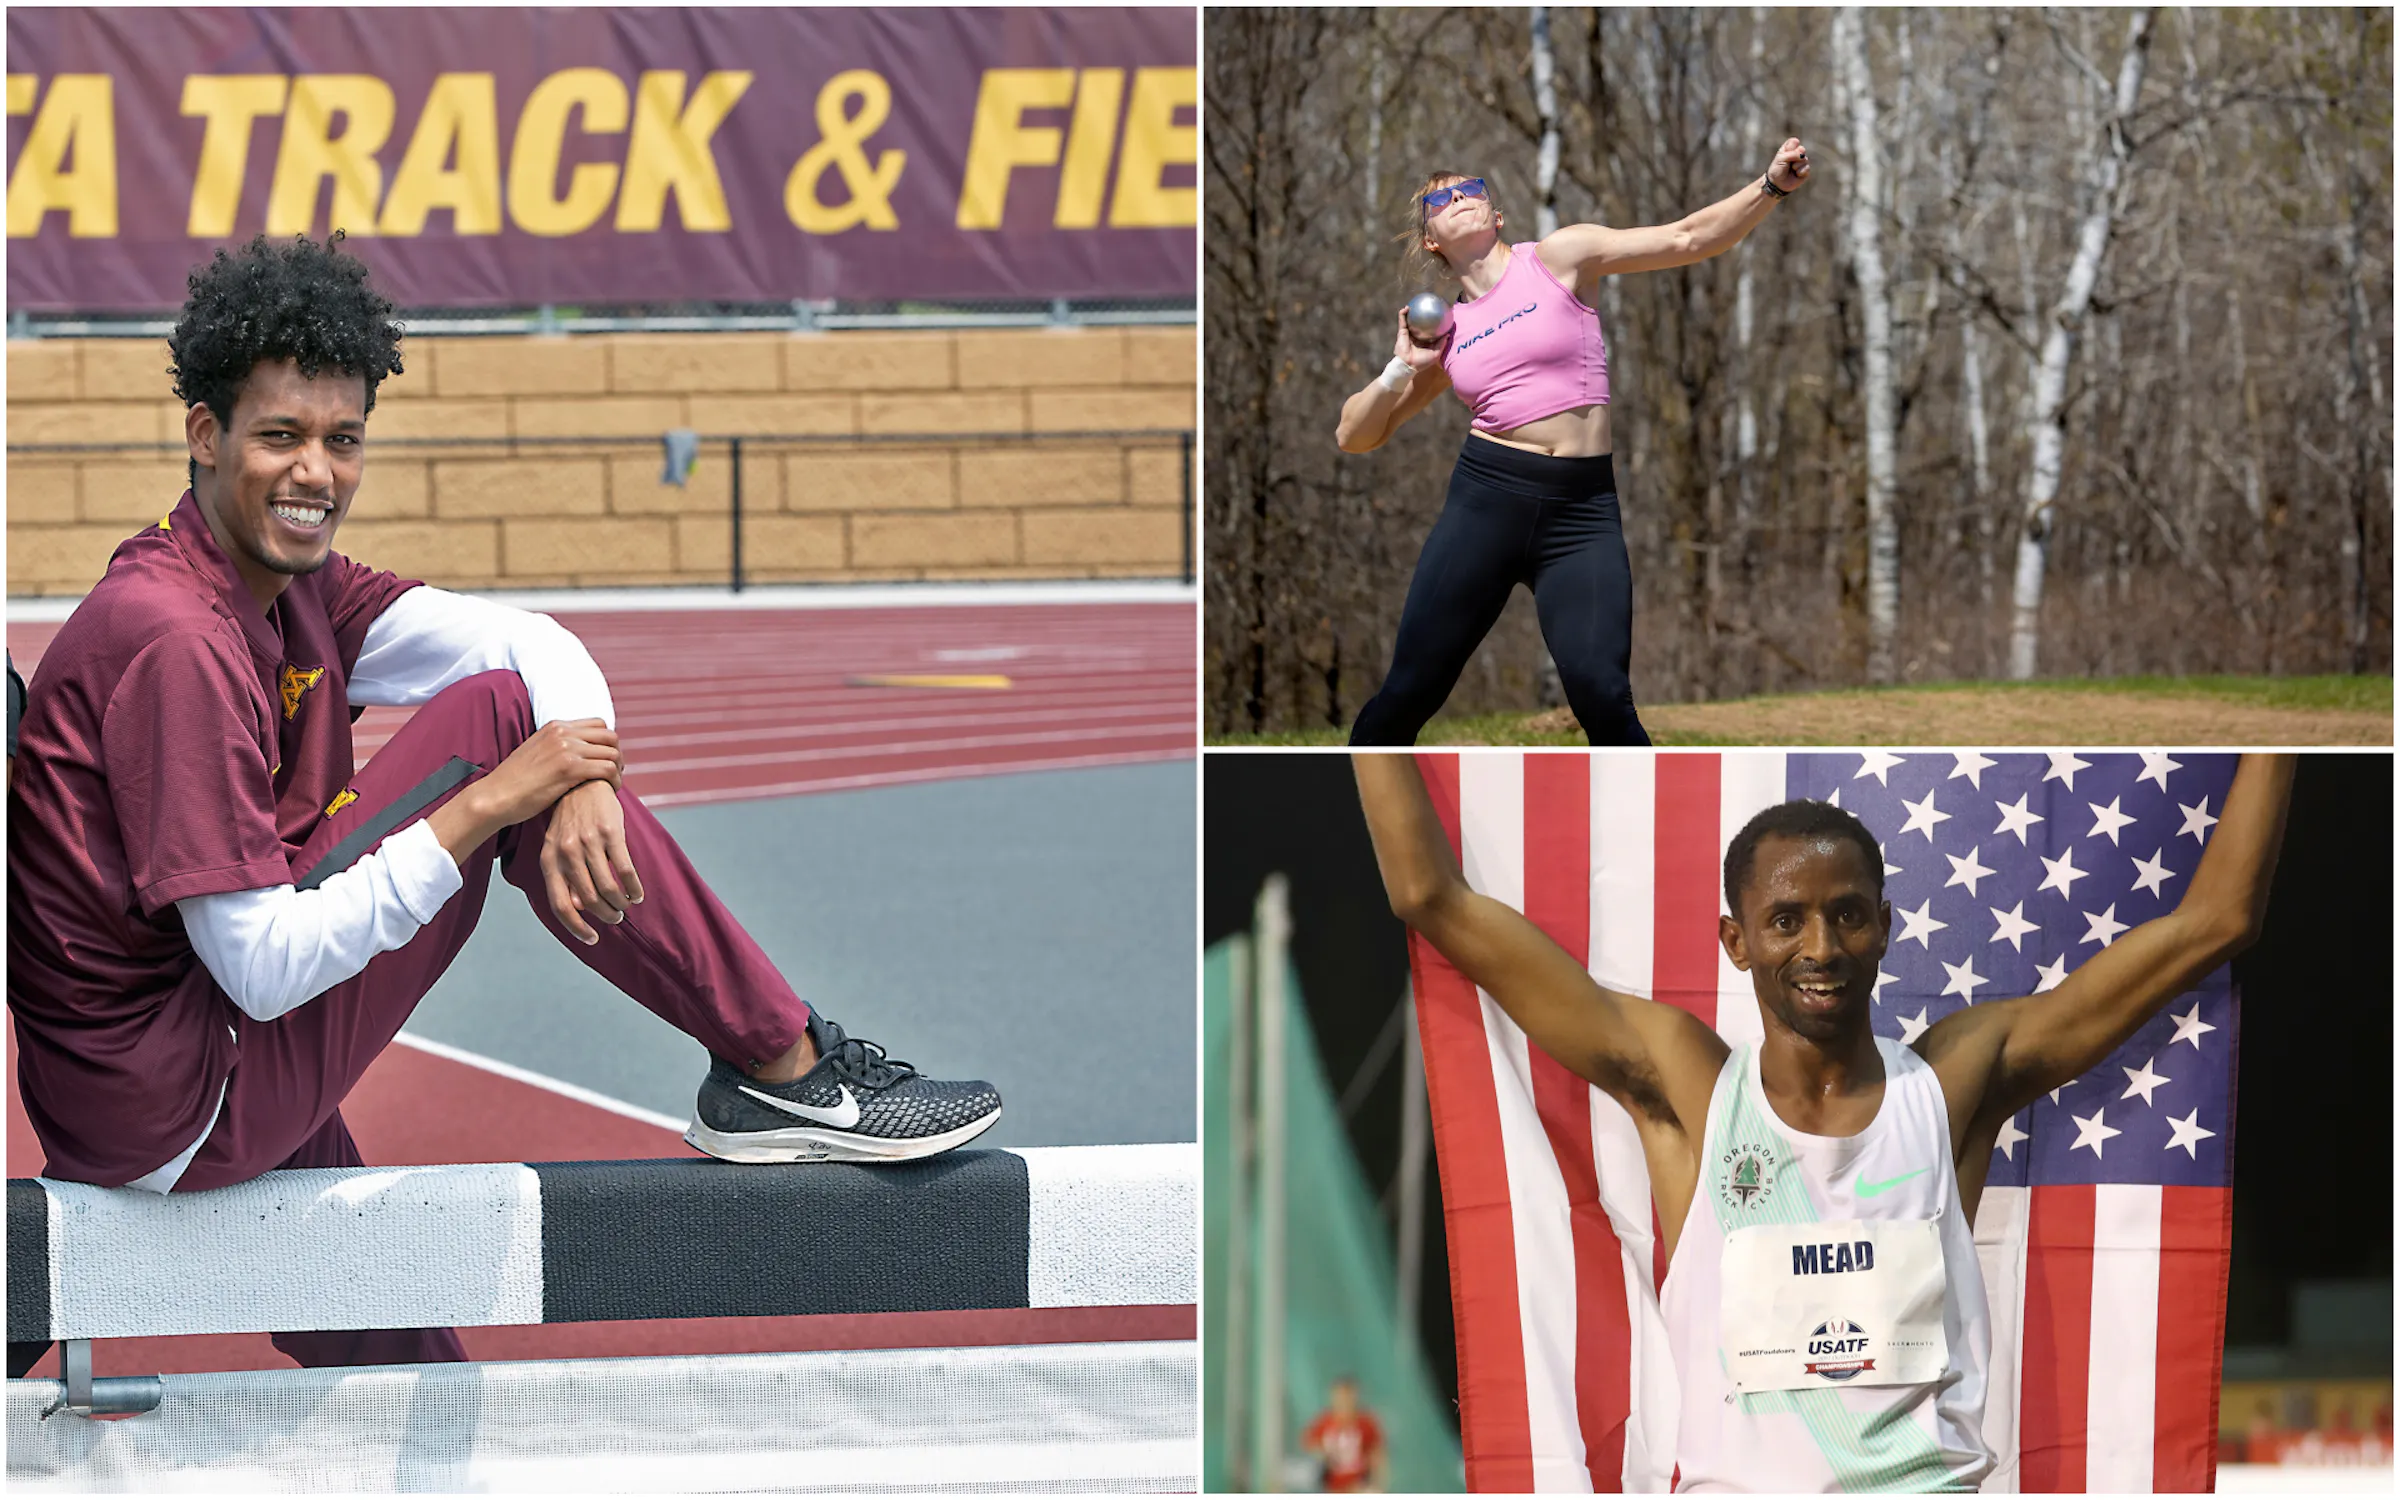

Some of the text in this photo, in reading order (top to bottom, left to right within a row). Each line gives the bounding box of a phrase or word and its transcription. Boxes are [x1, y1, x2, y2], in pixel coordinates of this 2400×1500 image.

[180, 66, 755, 238] TRACK
[783, 68, 907, 235] &
[955, 67, 1197, 229] FIE
[1457, 302, 1537, 354] NIKE PRO
[1723, 1144, 1776, 1166] OREGON
[1721, 1175, 1773, 1210] TRACK CLUB
[1792, 1240, 1875, 1275] MEAD
[1808, 1338, 1870, 1355] USATF
